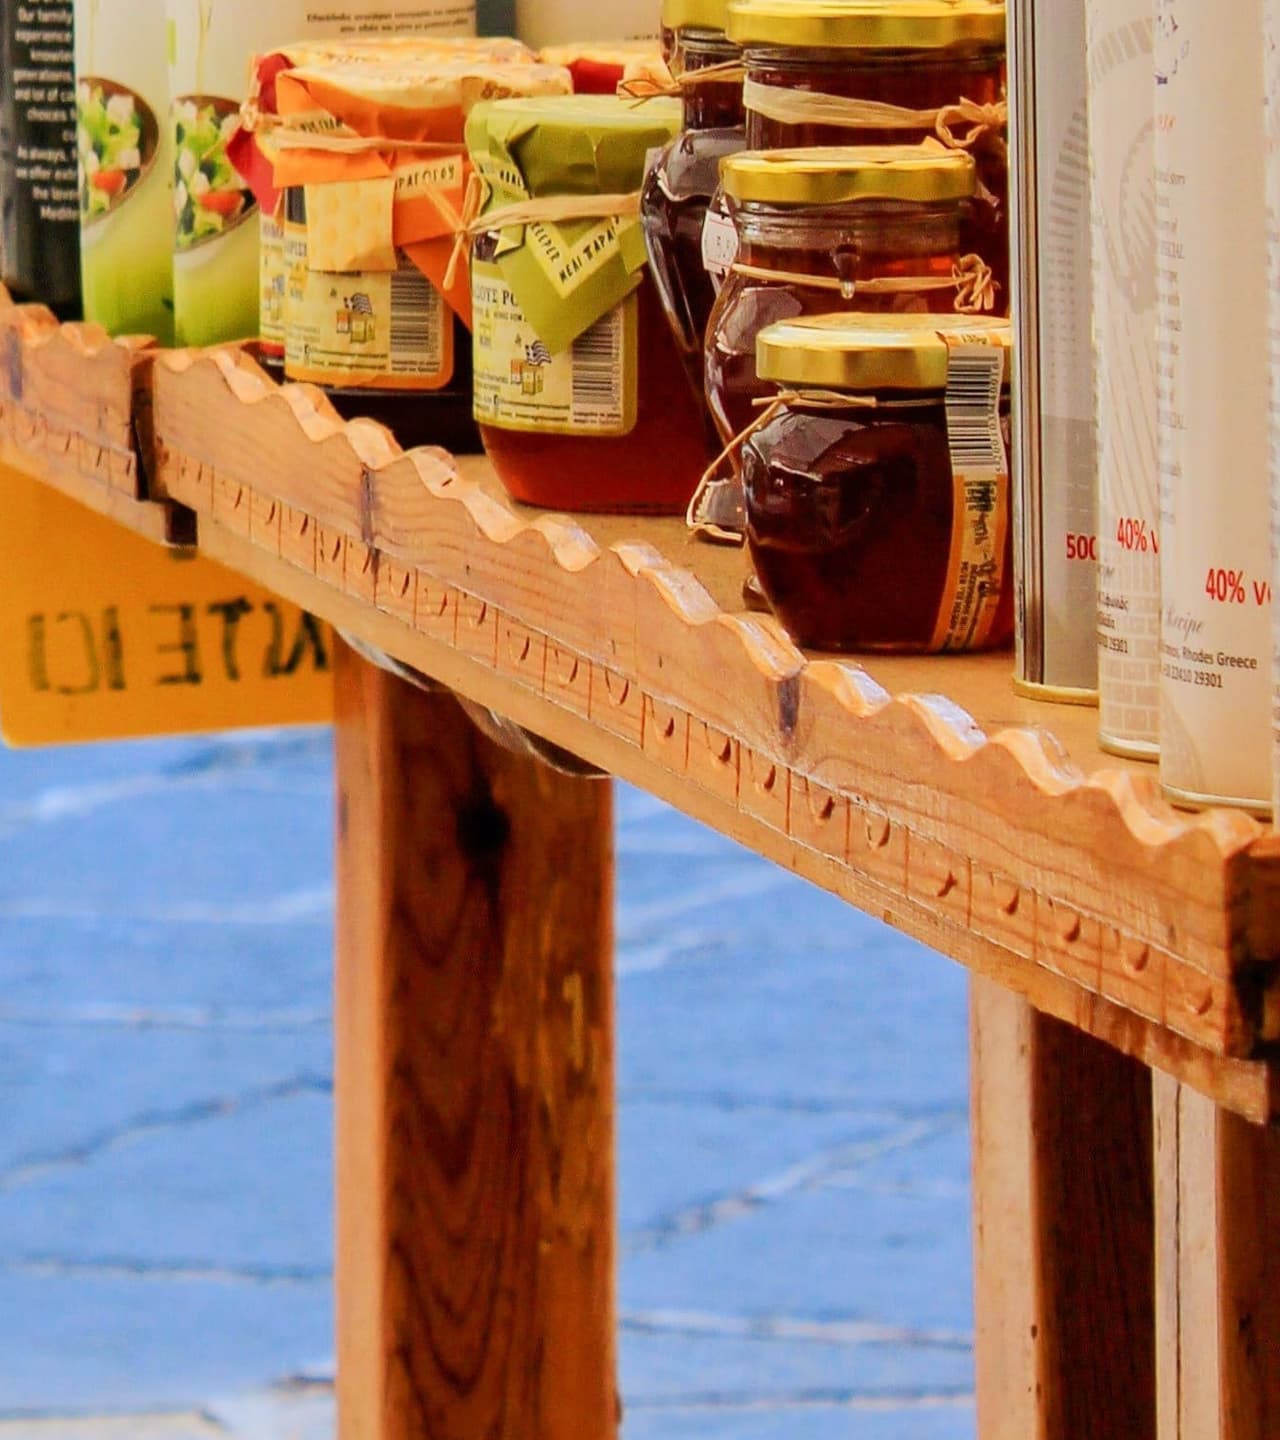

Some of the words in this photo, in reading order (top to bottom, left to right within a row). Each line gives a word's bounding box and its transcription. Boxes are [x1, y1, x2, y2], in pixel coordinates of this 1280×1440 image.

[1117, 516, 1148, 552] 40%
[1205, 567, 1246, 604] 40%
[1216, 651, 1258, 670] Greece
